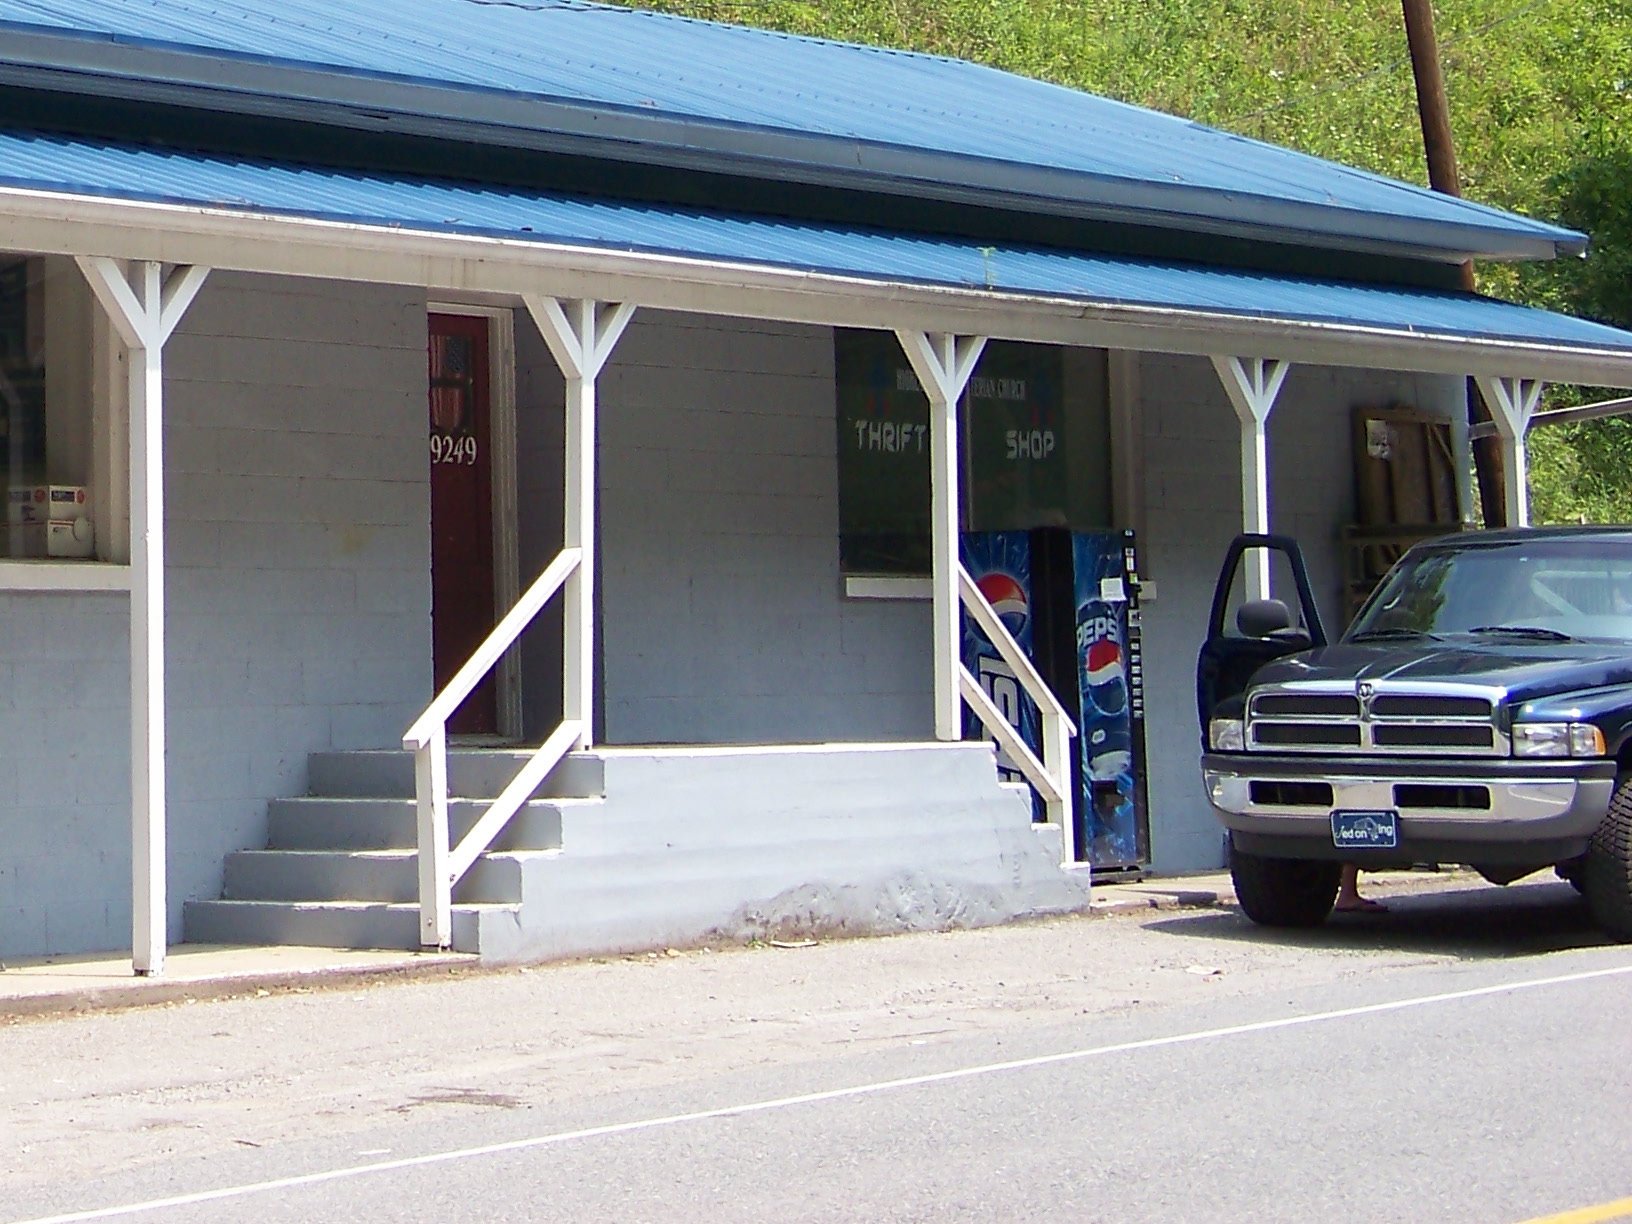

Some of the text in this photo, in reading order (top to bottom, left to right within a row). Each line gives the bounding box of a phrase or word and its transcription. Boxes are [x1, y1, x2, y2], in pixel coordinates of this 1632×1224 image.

[431, 435, 477, 465] 9249
[854, 419, 1056, 461] THRIFT SHOP
[1078, 616, 1118, 646] PEPS
[1354, 830, 1368, 838] on
